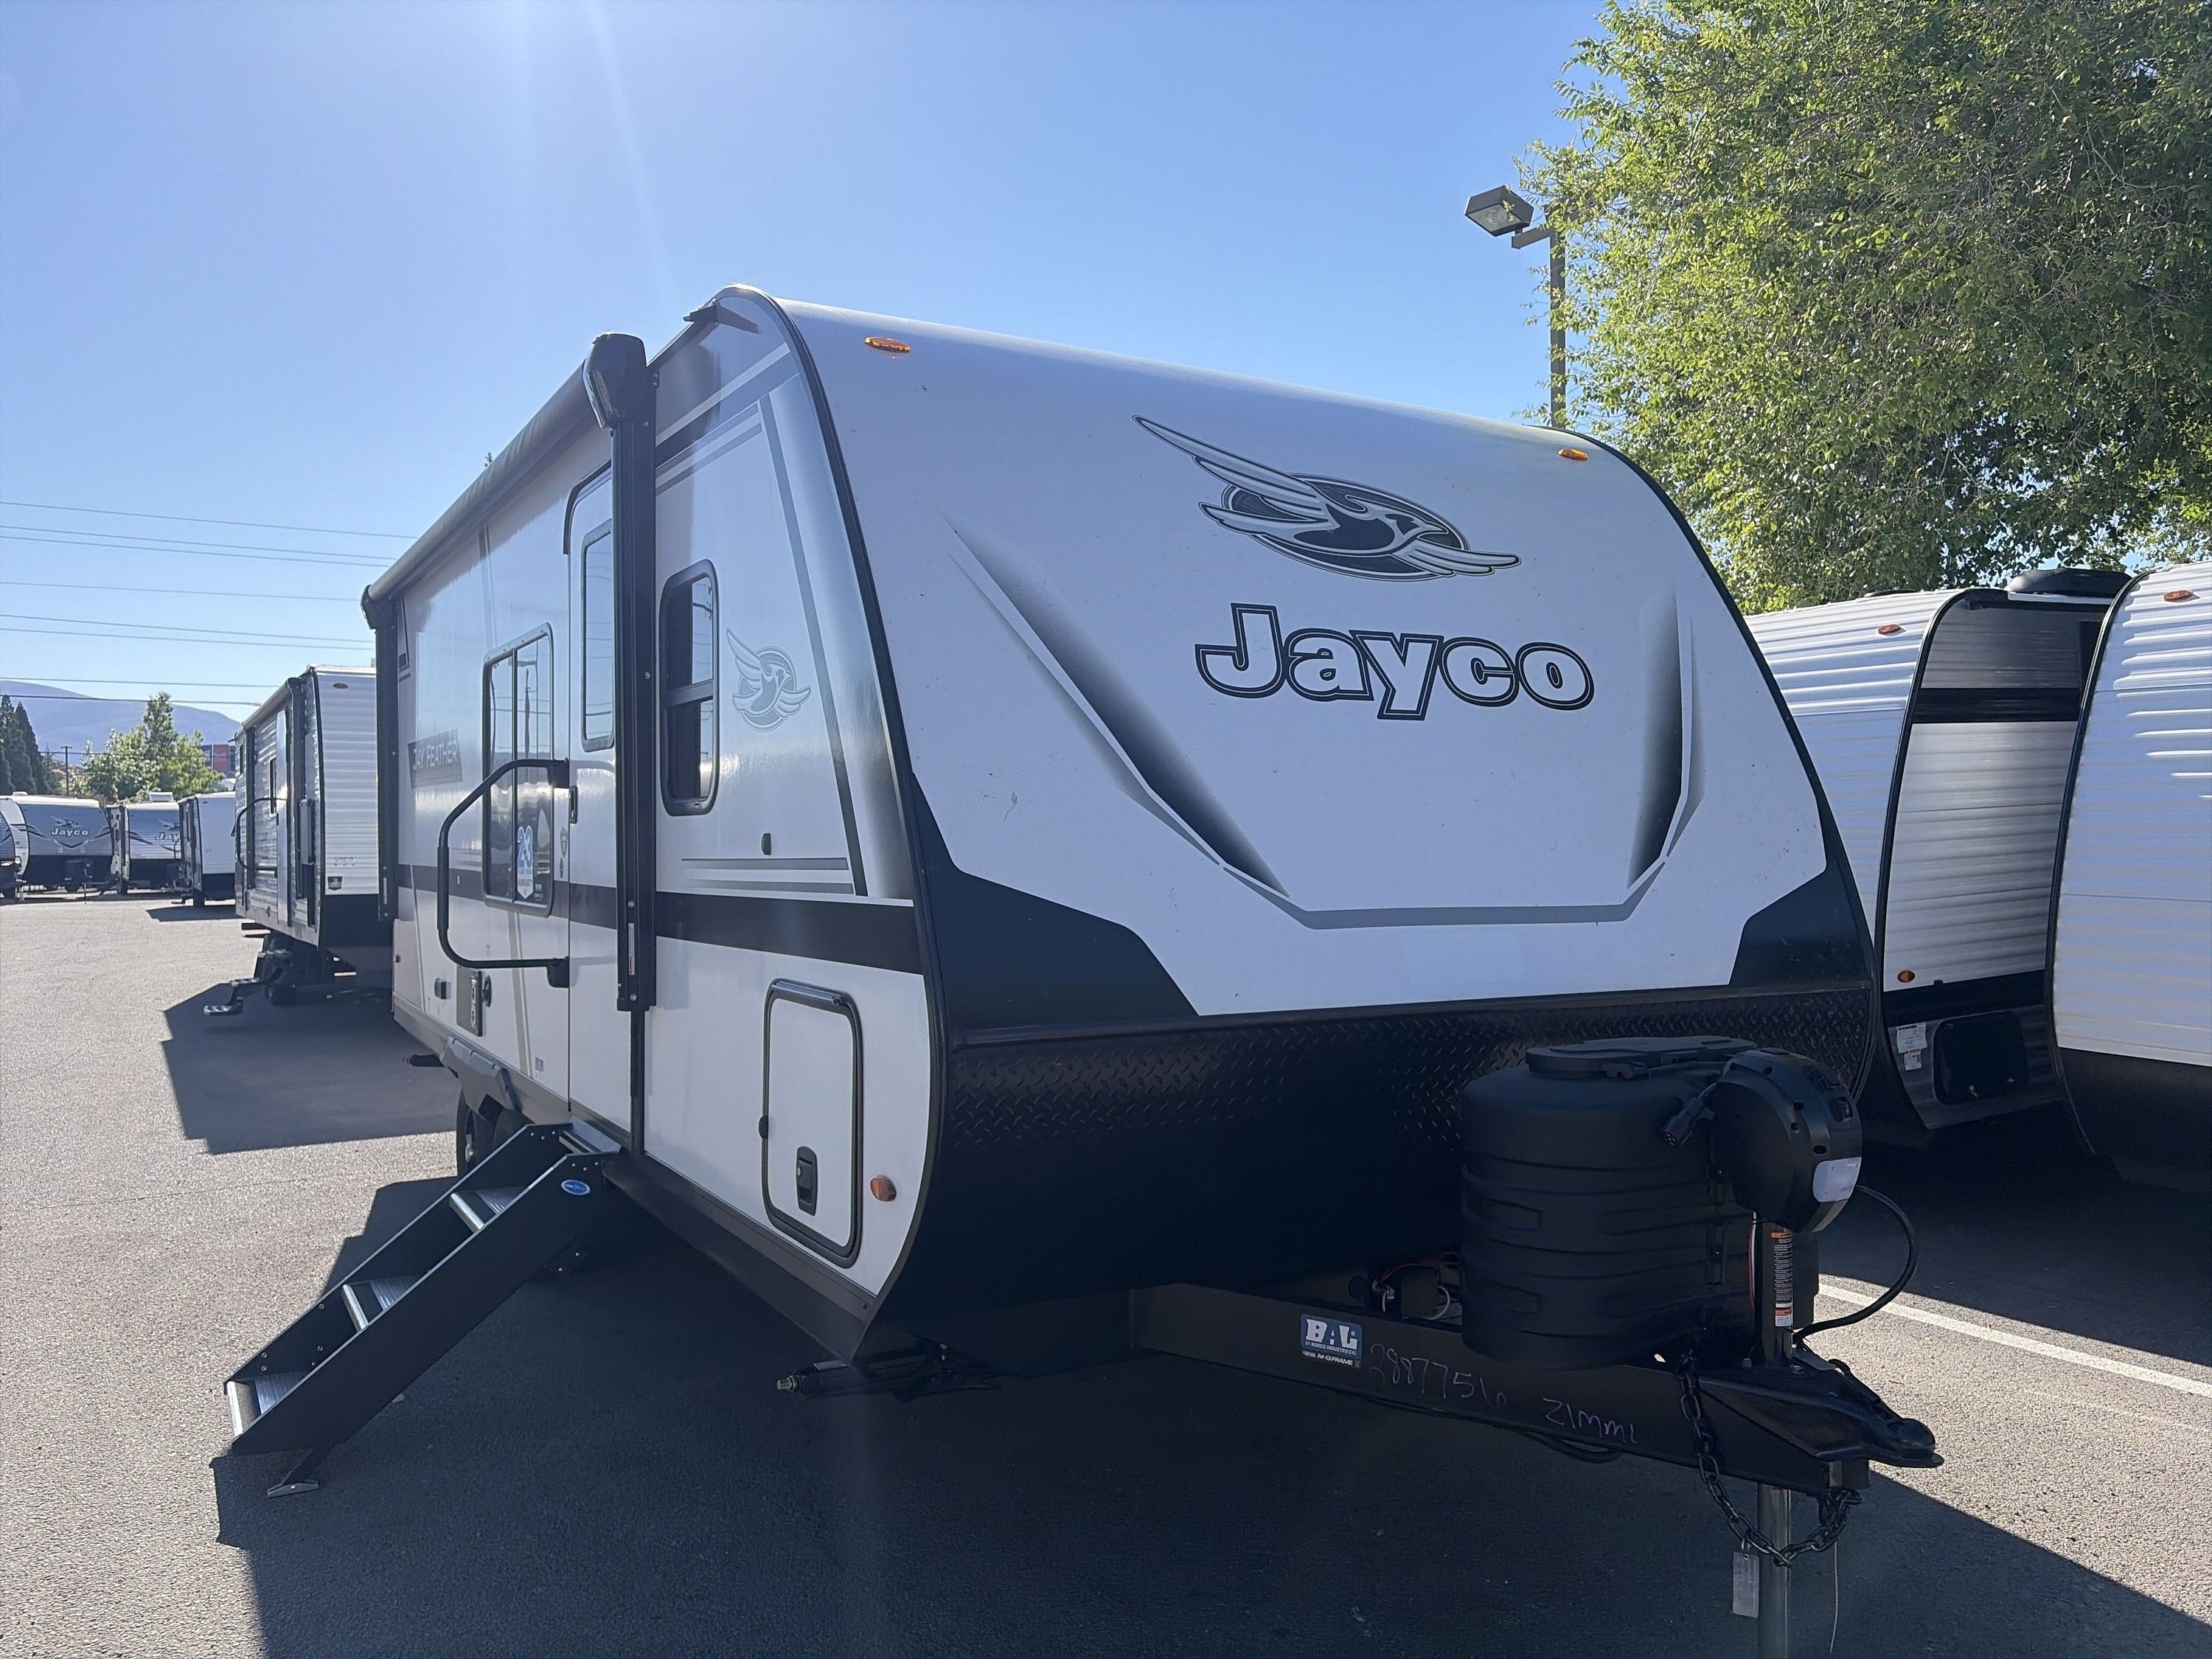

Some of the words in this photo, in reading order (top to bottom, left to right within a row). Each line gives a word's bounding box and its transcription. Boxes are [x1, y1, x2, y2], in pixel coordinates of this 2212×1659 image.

[1195, 602, 1595, 721] Jayco
[413, 747, 425, 772] JAY
[426, 740, 457, 768] FEATHER
[51, 827, 88, 837] Jayco
[155, 832, 180, 842] Jay
[1326, 1346, 1352, 1354] INDUSTRIES
